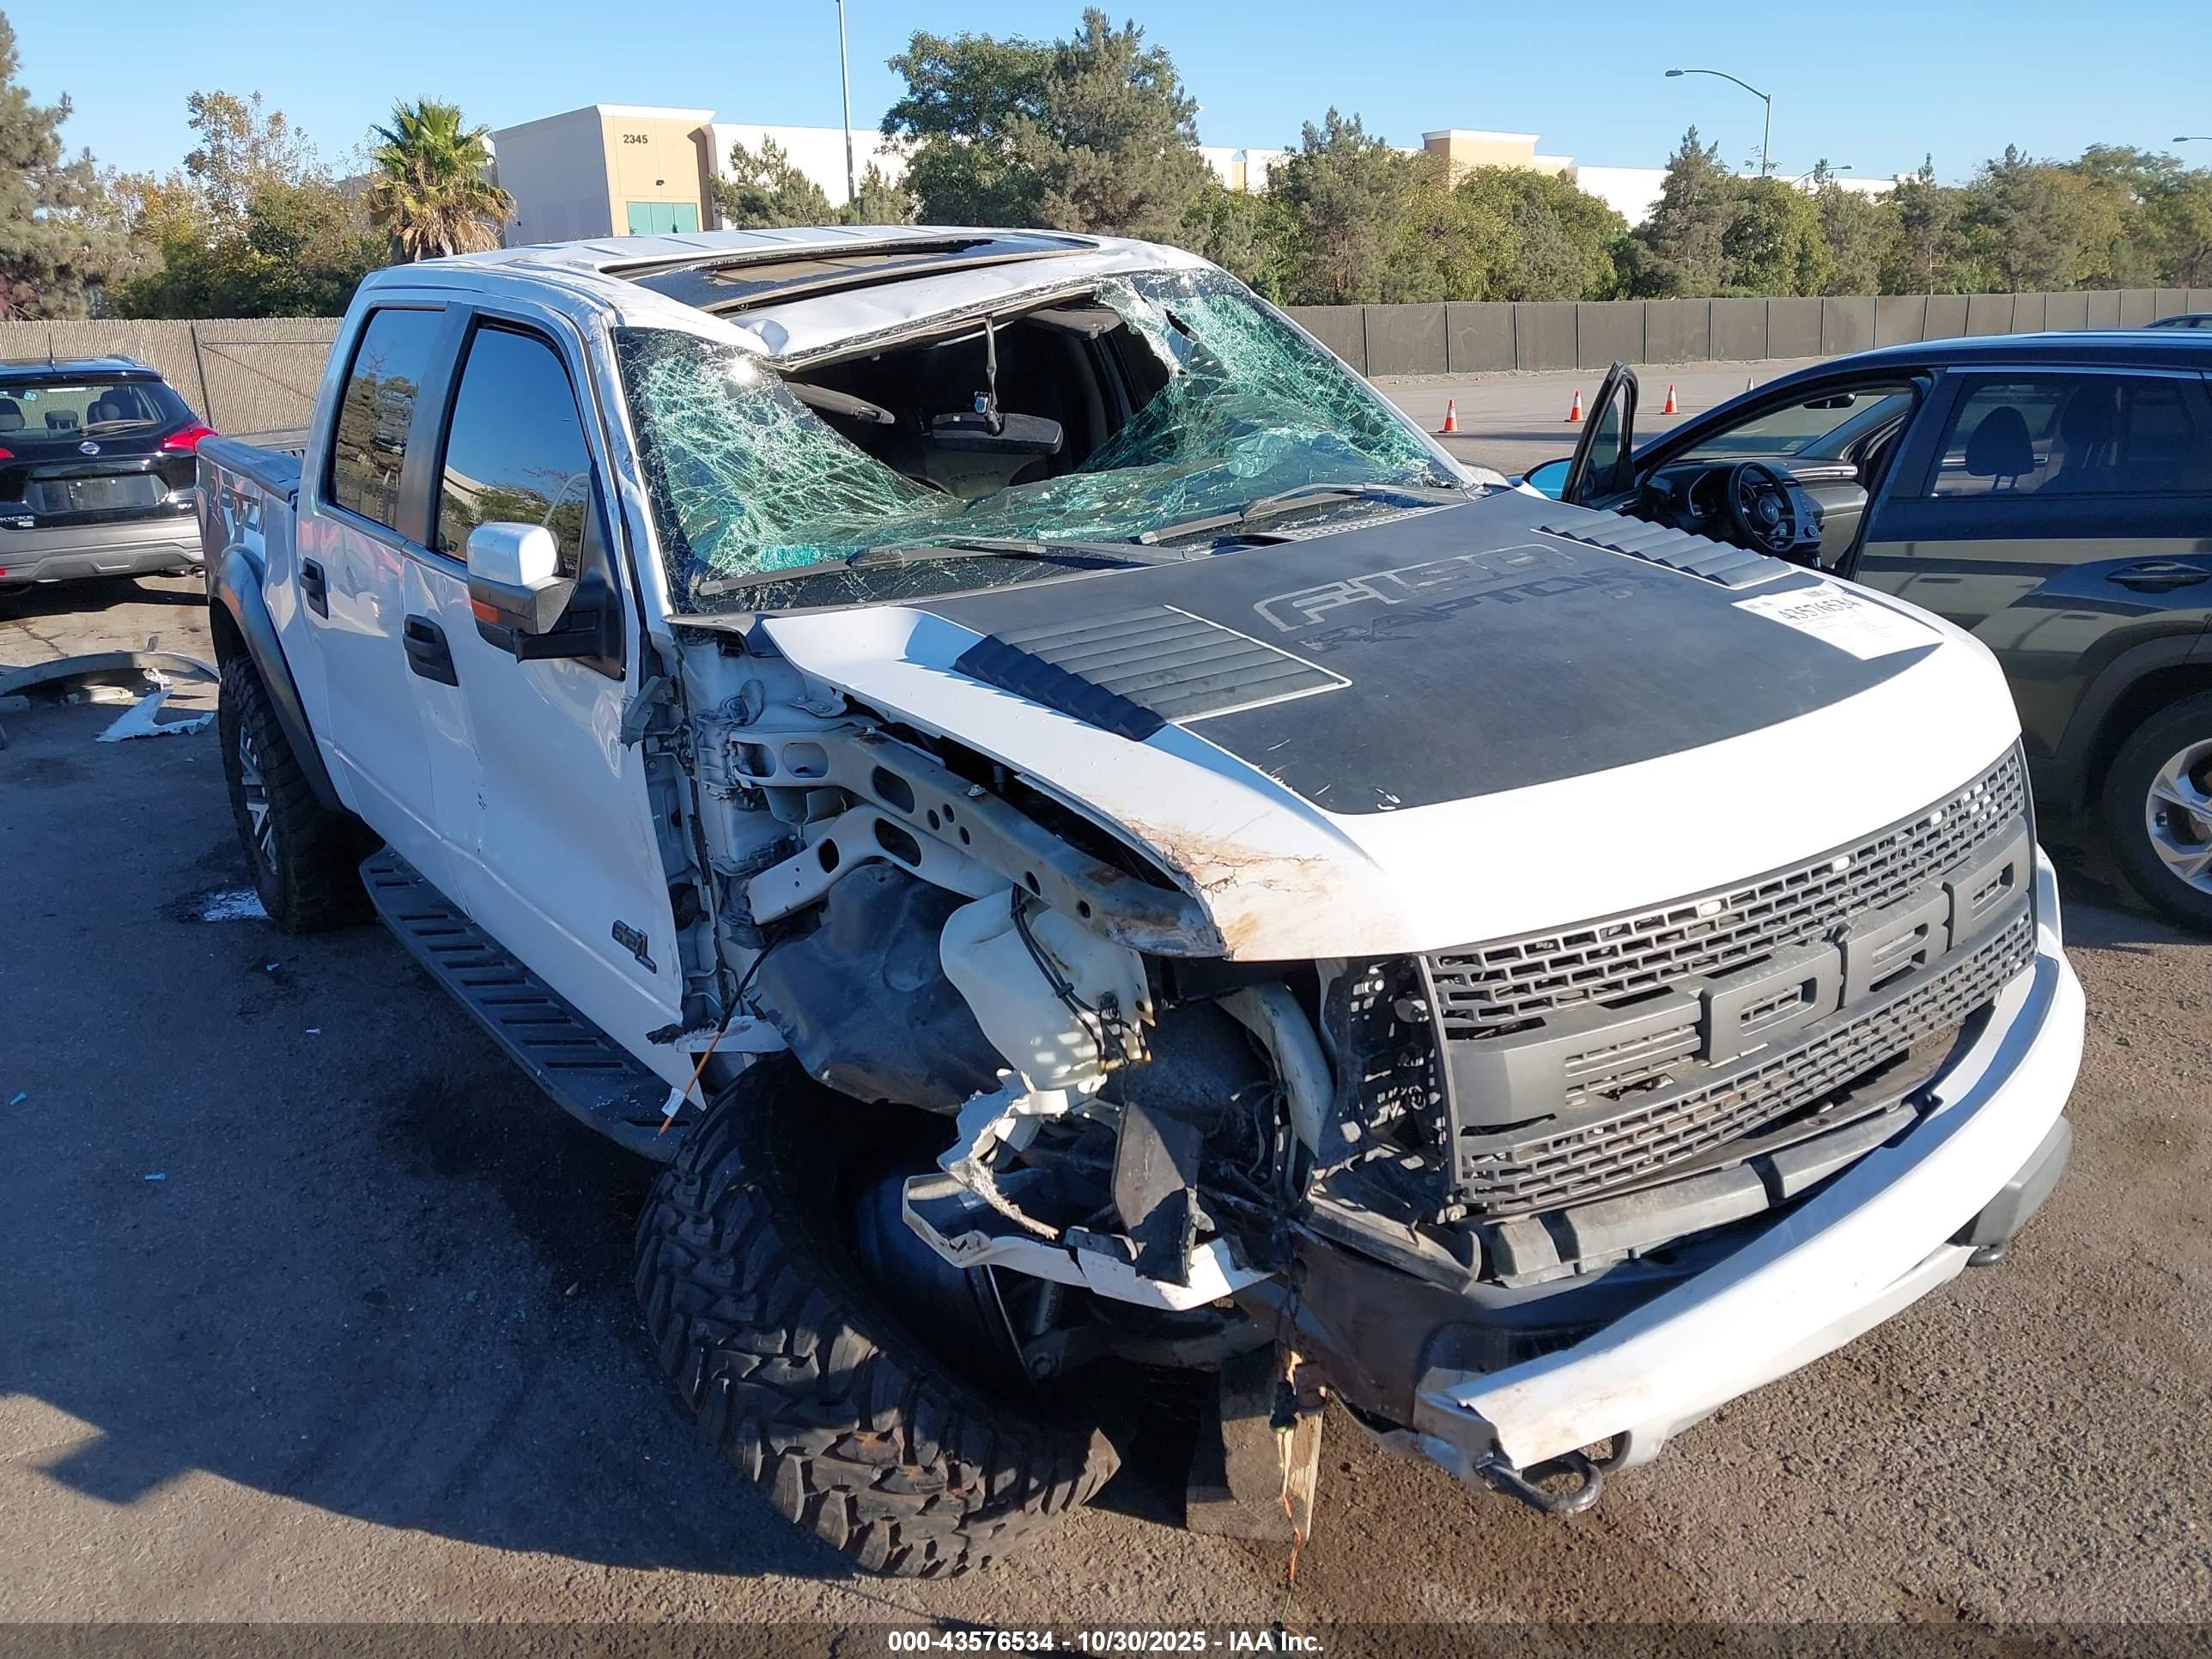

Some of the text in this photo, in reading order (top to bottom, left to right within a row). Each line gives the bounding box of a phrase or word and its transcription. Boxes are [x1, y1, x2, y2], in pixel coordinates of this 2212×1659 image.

[623, 134, 648, 144] 2345
[1778, 597, 1863, 619] 43576534
[1448, 818, 2032, 1127] FORD
